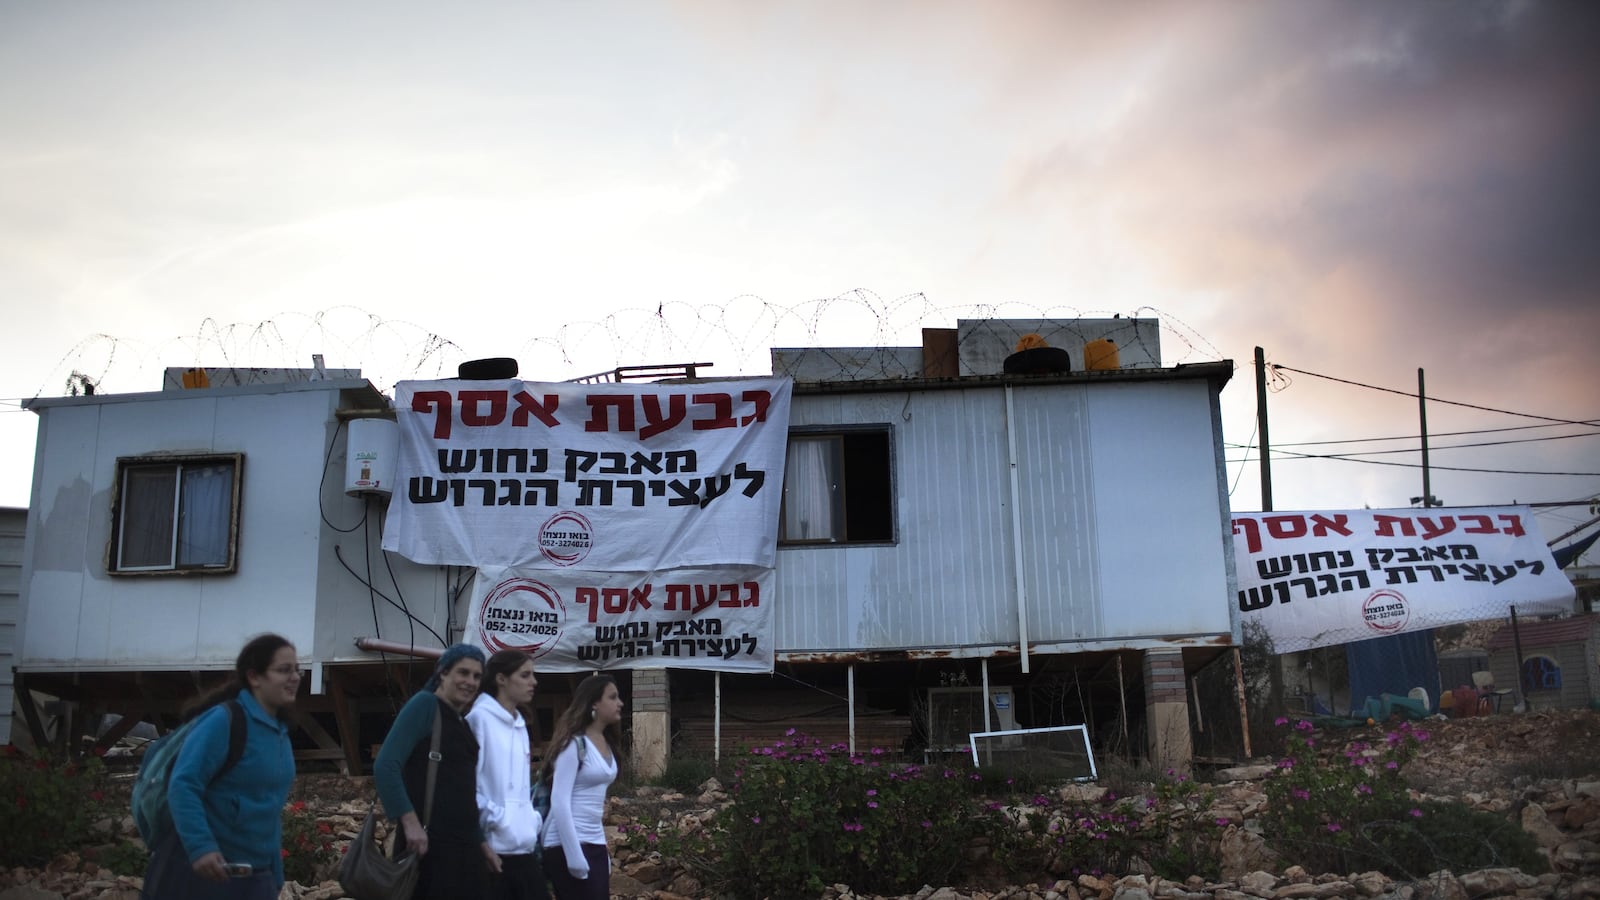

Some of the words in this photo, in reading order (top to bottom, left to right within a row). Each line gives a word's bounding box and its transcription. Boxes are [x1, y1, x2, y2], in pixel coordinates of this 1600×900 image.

[412, 390, 561, 440] אסף
[585, 390, 771, 441] גבעת
[438, 448, 548, 473] נחוש
[565, 448, 697, 482] מאבק
[408, 476, 559, 506] הגרוש
[575, 462, 765, 509] לעצירת
[569, 532, 590, 540] בואו
[1231, 513, 1354, 554] אסף
[1373, 514, 1526, 541] גבעת
[1256, 550, 1354, 580] נחוש
[1365, 544, 1479, 571] מאבק
[1384, 559, 1545, 586] לעצירת
[575, 584, 653, 624] אסף
[664, 581, 760, 615] גבעת
[1238, 570, 1371, 612] הגרוש
[487, 607, 525, 620] ננצח!
[529, 611, 559, 624] בואו
[486, 621, 558, 636] 052-3274026
[655, 618, 722, 643] מאבק
[661, 632, 757, 660] לעצירת
